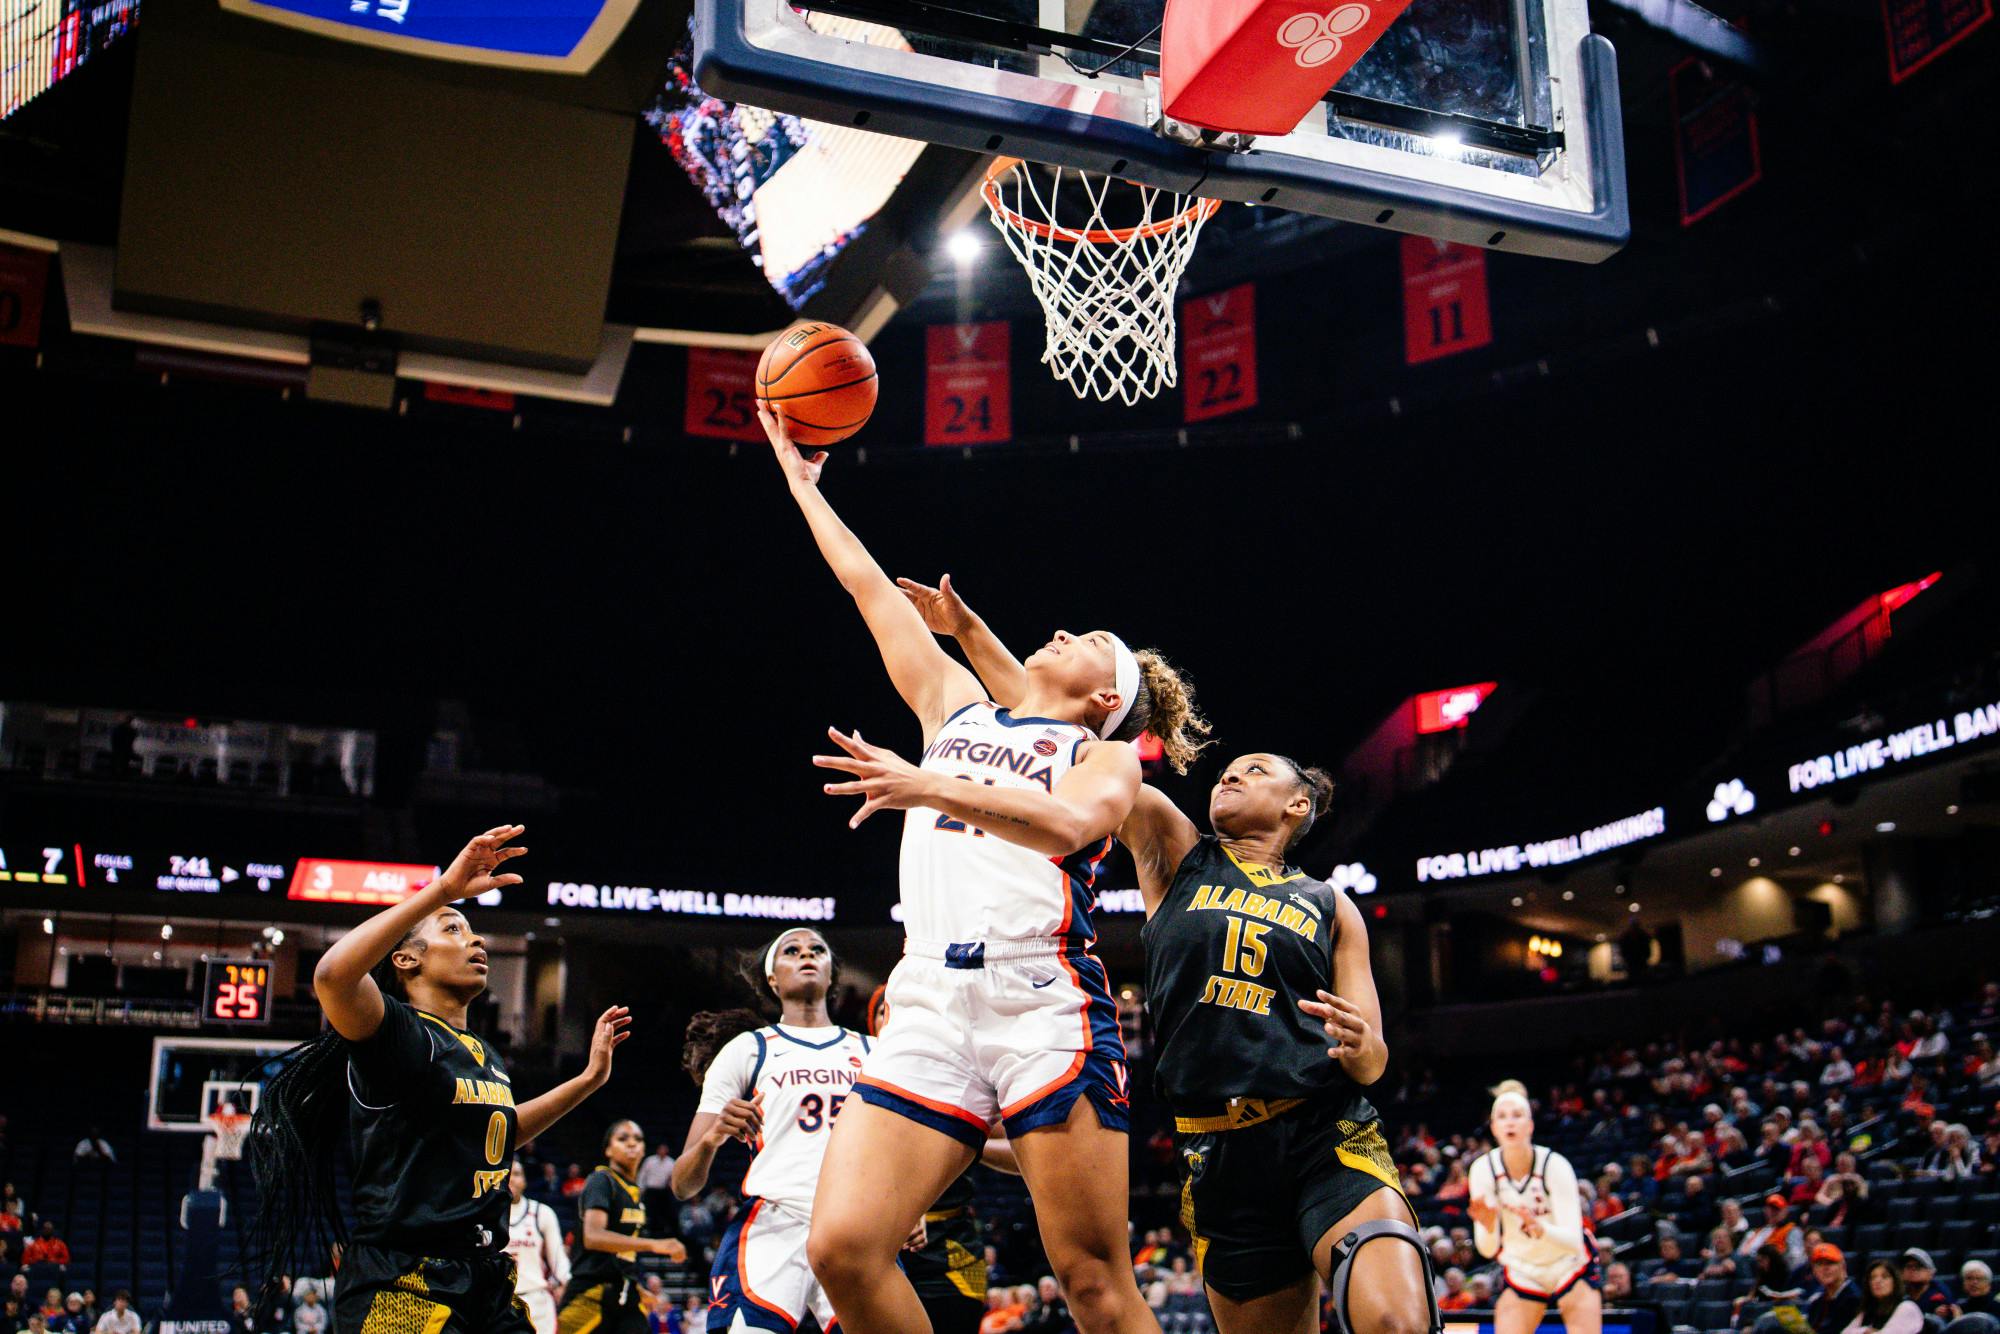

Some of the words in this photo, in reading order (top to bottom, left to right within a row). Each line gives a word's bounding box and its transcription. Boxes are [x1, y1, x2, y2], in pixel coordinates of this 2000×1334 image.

[1429, 302, 1464, 346] 11
[1200, 363, 1241, 407] 22
[704, 388, 752, 427] 25
[944, 395, 990, 432] 24
[929, 737, 1053, 795] VIRGINIA
[1788, 755, 1835, 793] FOR
[1834, 719, 1955, 779] LIVE-WELL
[42, 847, 64, 874] 7
[313, 865, 333, 890] 3
[1417, 854, 1467, 882] FOR
[1467, 834, 1581, 876] LIVE-WELL
[363, 871, 408, 890] ASU
[548, 882, 599, 908] FOR
[600, 885, 723, 915] LIVE-WELL
[723, 893, 835, 920] BANKING!
[1186, 885, 1318, 943] ALABAMA
[1222, 915, 1274, 978] 15
[215, 983, 258, 1019] 25
[1199, 975, 1277, 1016] STATE
[485, 1110, 508, 1165] 0
[175, 1320, 231, 1333] UNITED
